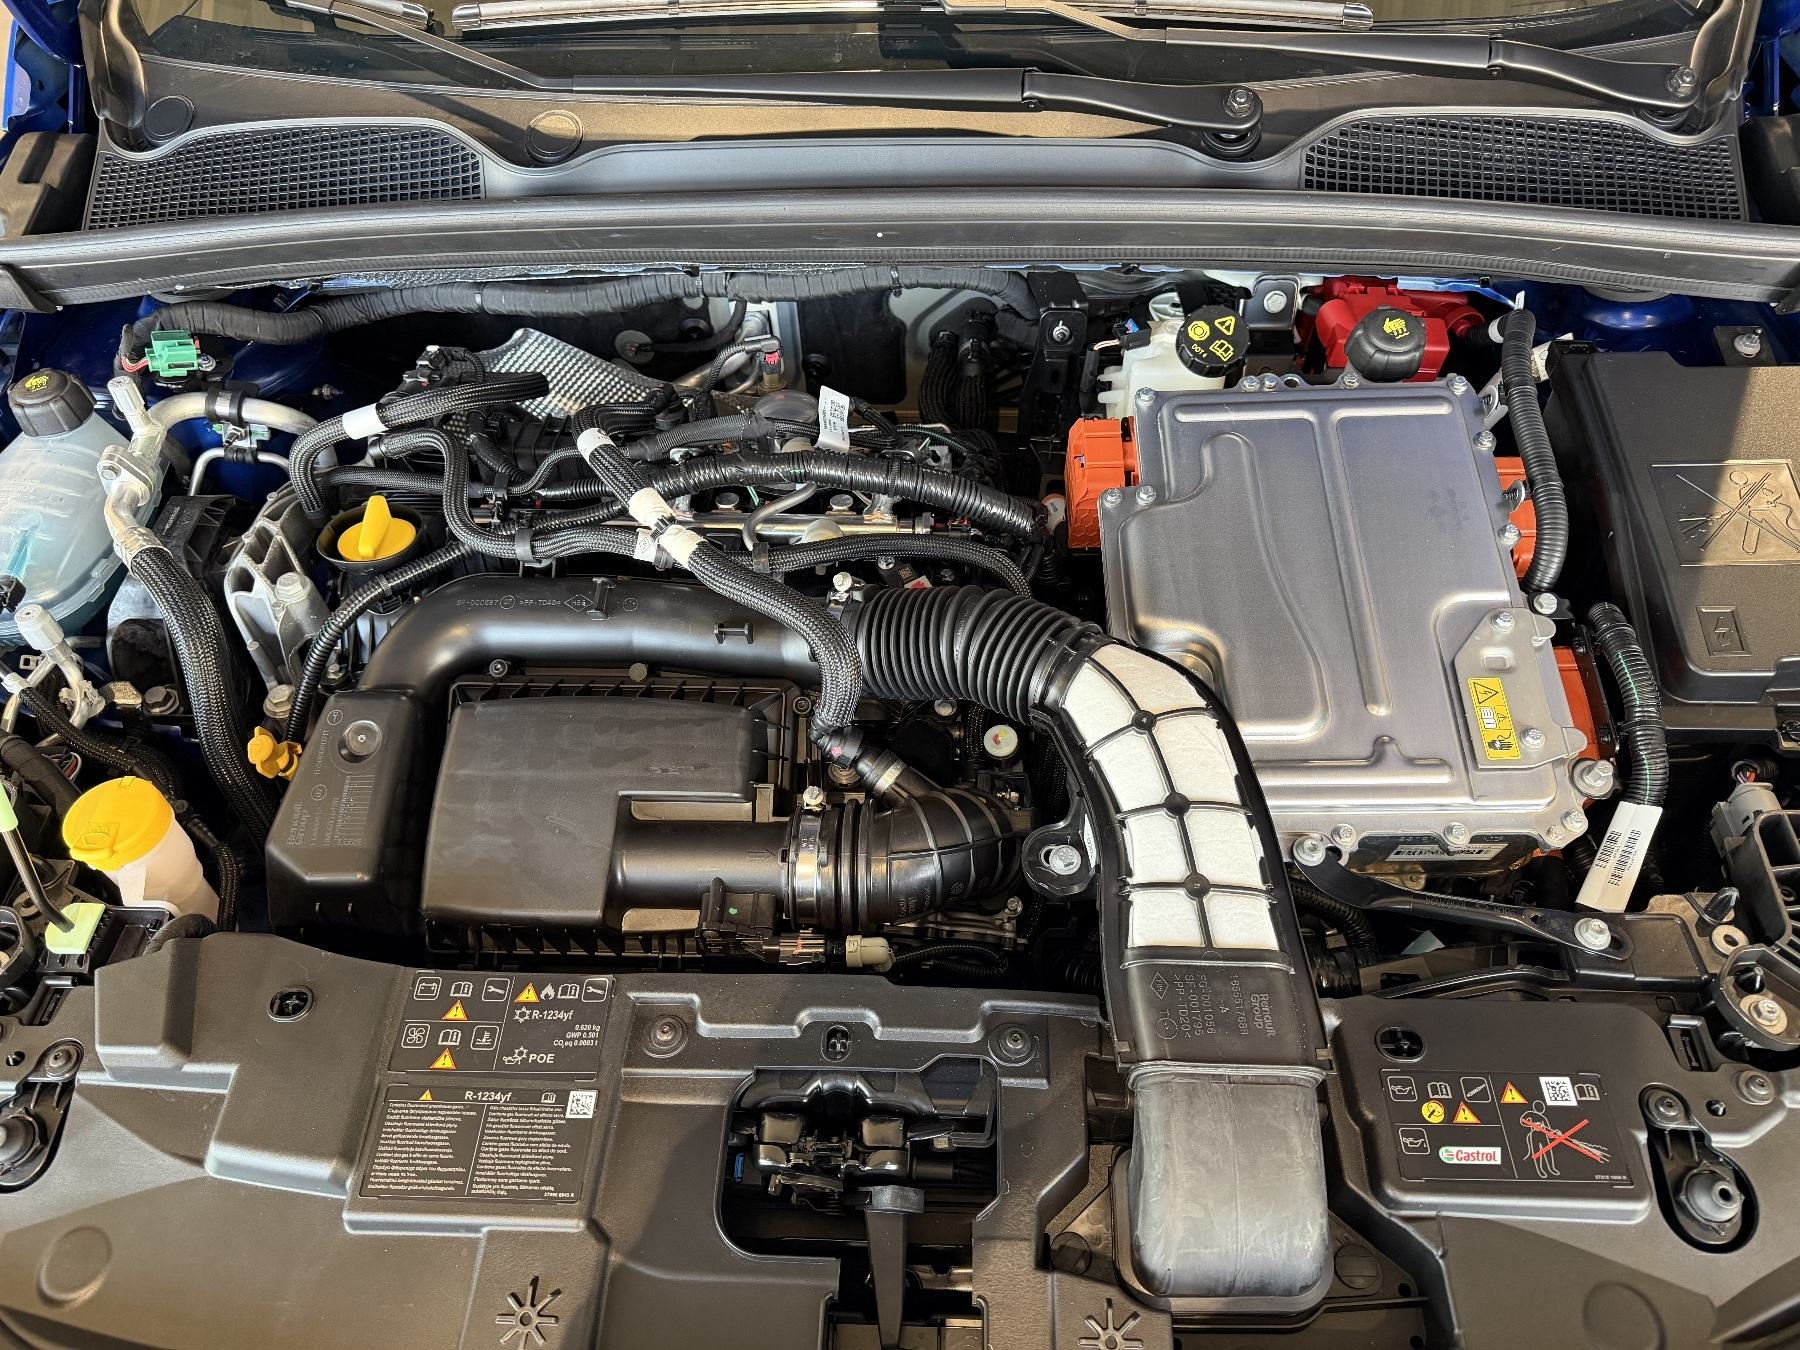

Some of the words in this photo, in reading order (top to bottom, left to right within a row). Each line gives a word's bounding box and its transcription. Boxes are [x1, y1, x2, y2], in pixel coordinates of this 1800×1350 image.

[1191, 343, 1205, 354] DOT
[1185, 974, 1204, 1036] SF-001795
[531, 1009, 574, 1021] R-1234yf
[1250, 994, 1264, 1030] Group
[1259, 993, 1277, 1038] Renault
[592, 1024, 601, 1032] kg
[565, 1031, 582, 1039] GWP
[528, 1053, 555, 1064] POE
[464, 1091, 512, 1102] R-1234yf
[1455, 1149, 1498, 1162] Castrol
